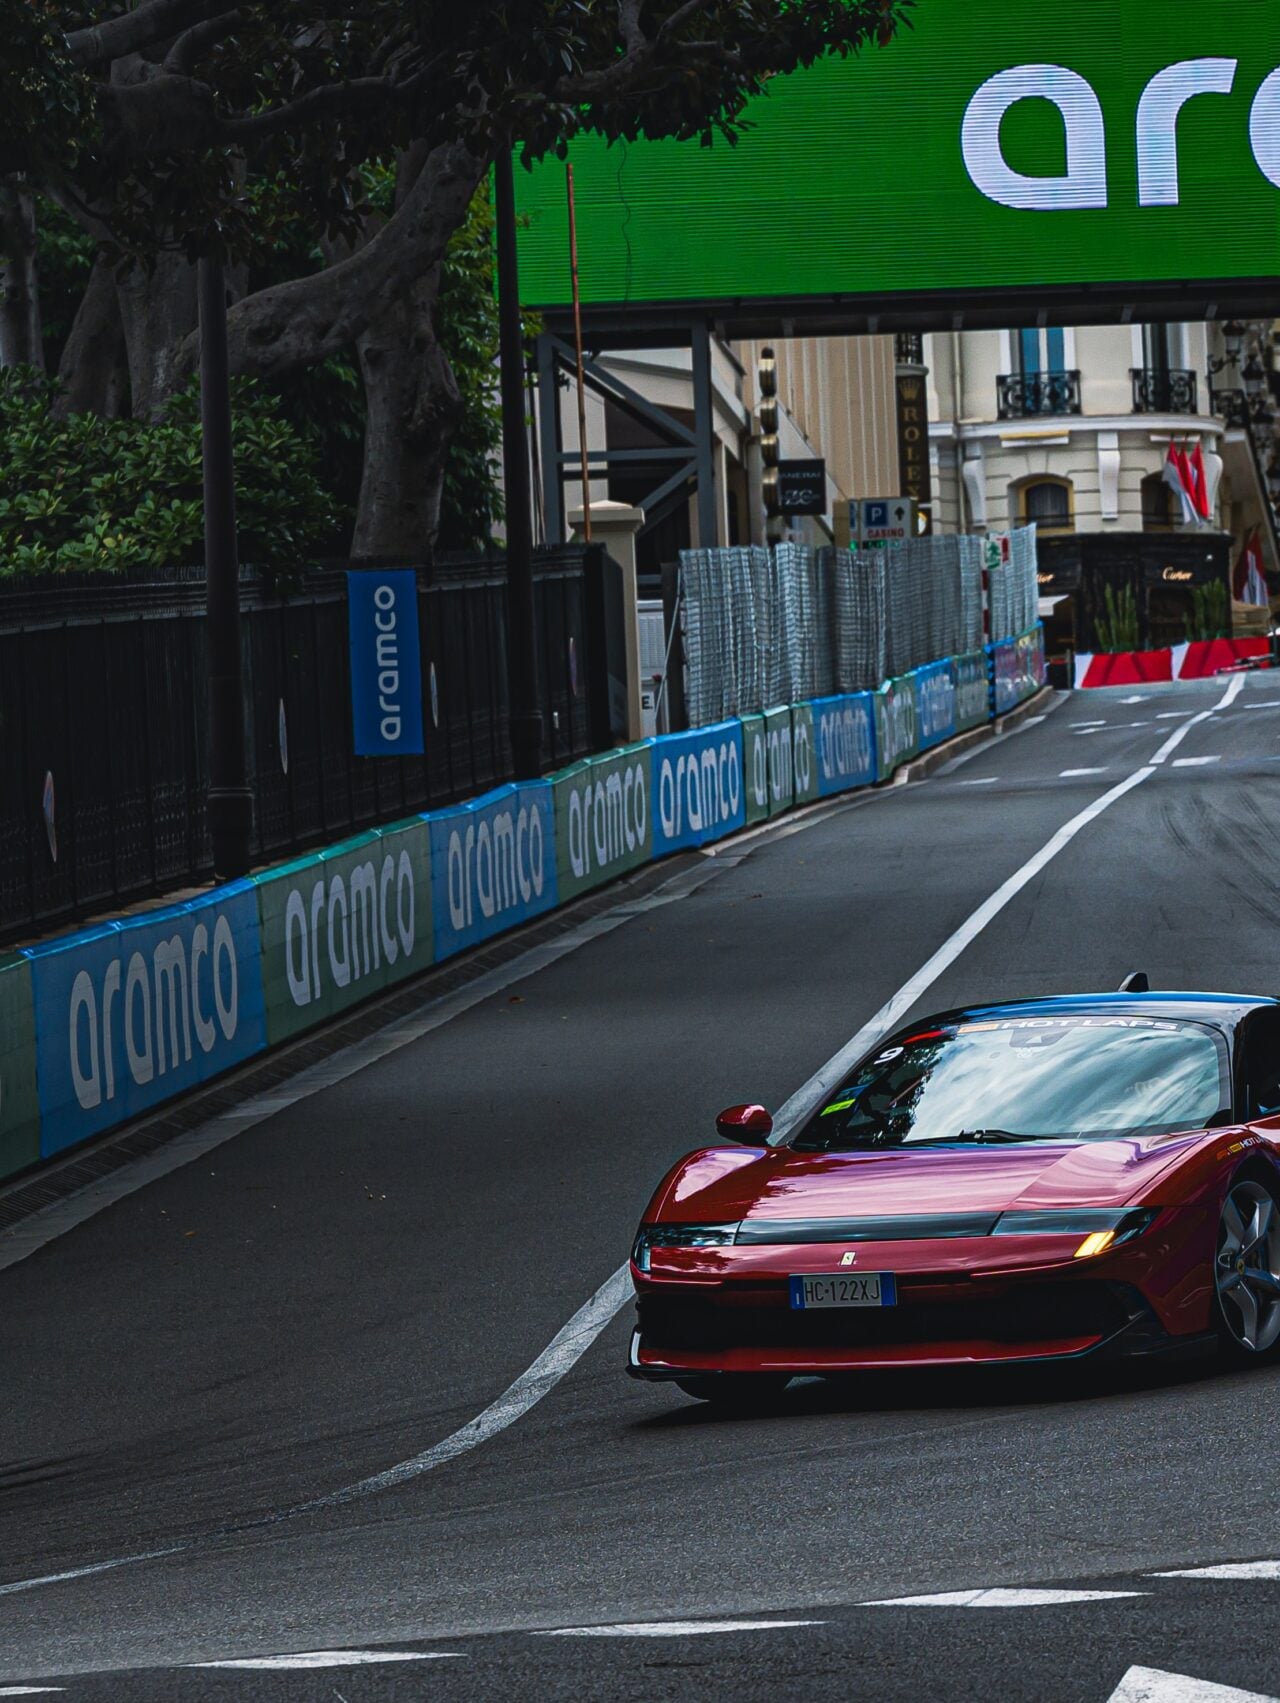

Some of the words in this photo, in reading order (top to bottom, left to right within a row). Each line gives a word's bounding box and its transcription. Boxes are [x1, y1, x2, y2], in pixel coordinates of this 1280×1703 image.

[902, 406, 922, 499] ROLEX
[872, 507, 882, 522] P
[374, 585, 402, 742] aramco
[568, 763, 647, 879] aramco
[659, 740, 739, 838] aramco
[449, 804, 543, 931] aramco
[285, 849, 415, 1006] aramco
[69, 914, 238, 1110] aramco
[873, 1046, 904, 1065] 9
[1001, 1019, 1078, 1029] HOT
[1083, 1019, 1178, 1030] LAPS
